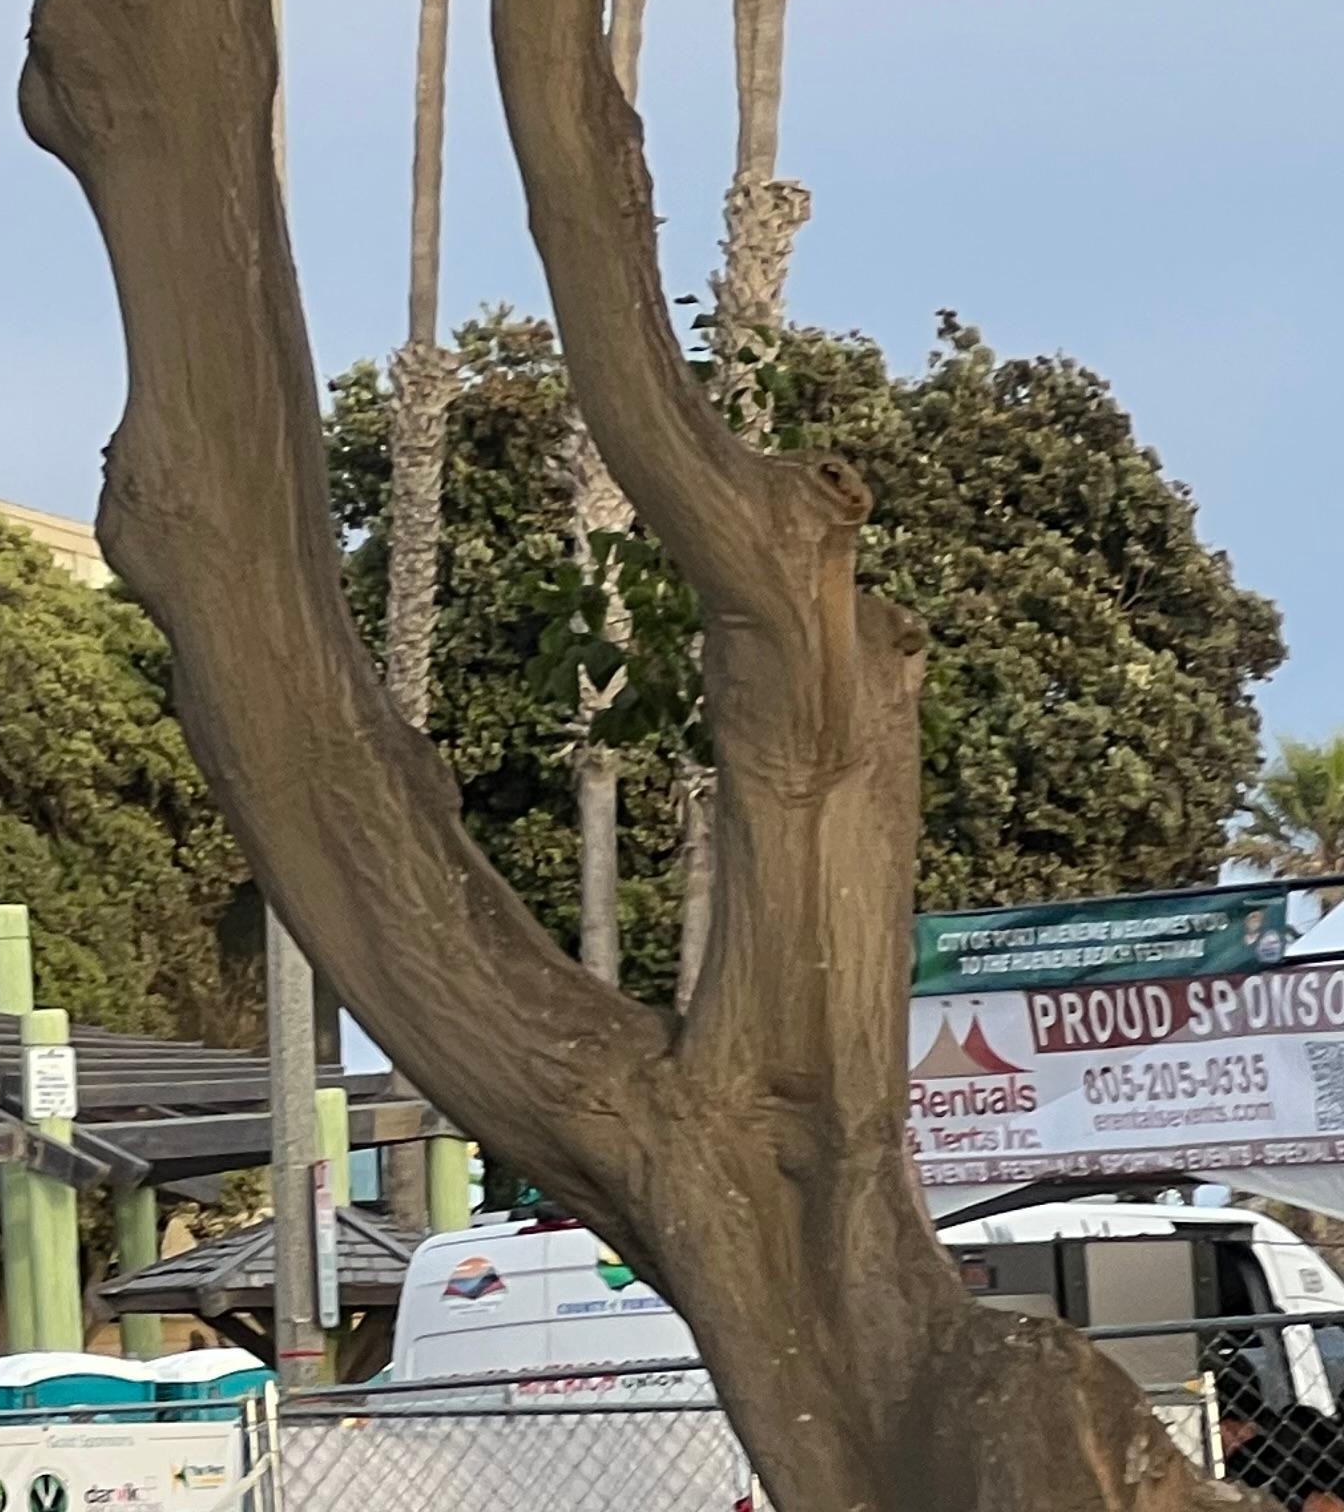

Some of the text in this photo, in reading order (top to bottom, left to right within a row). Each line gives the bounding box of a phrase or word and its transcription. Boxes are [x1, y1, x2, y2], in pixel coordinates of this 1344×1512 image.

[1033, 985, 1172, 1048] PROUD
[908, 1076, 1037, 1119] Rentals
[929, 1125, 999, 1152] Tents
